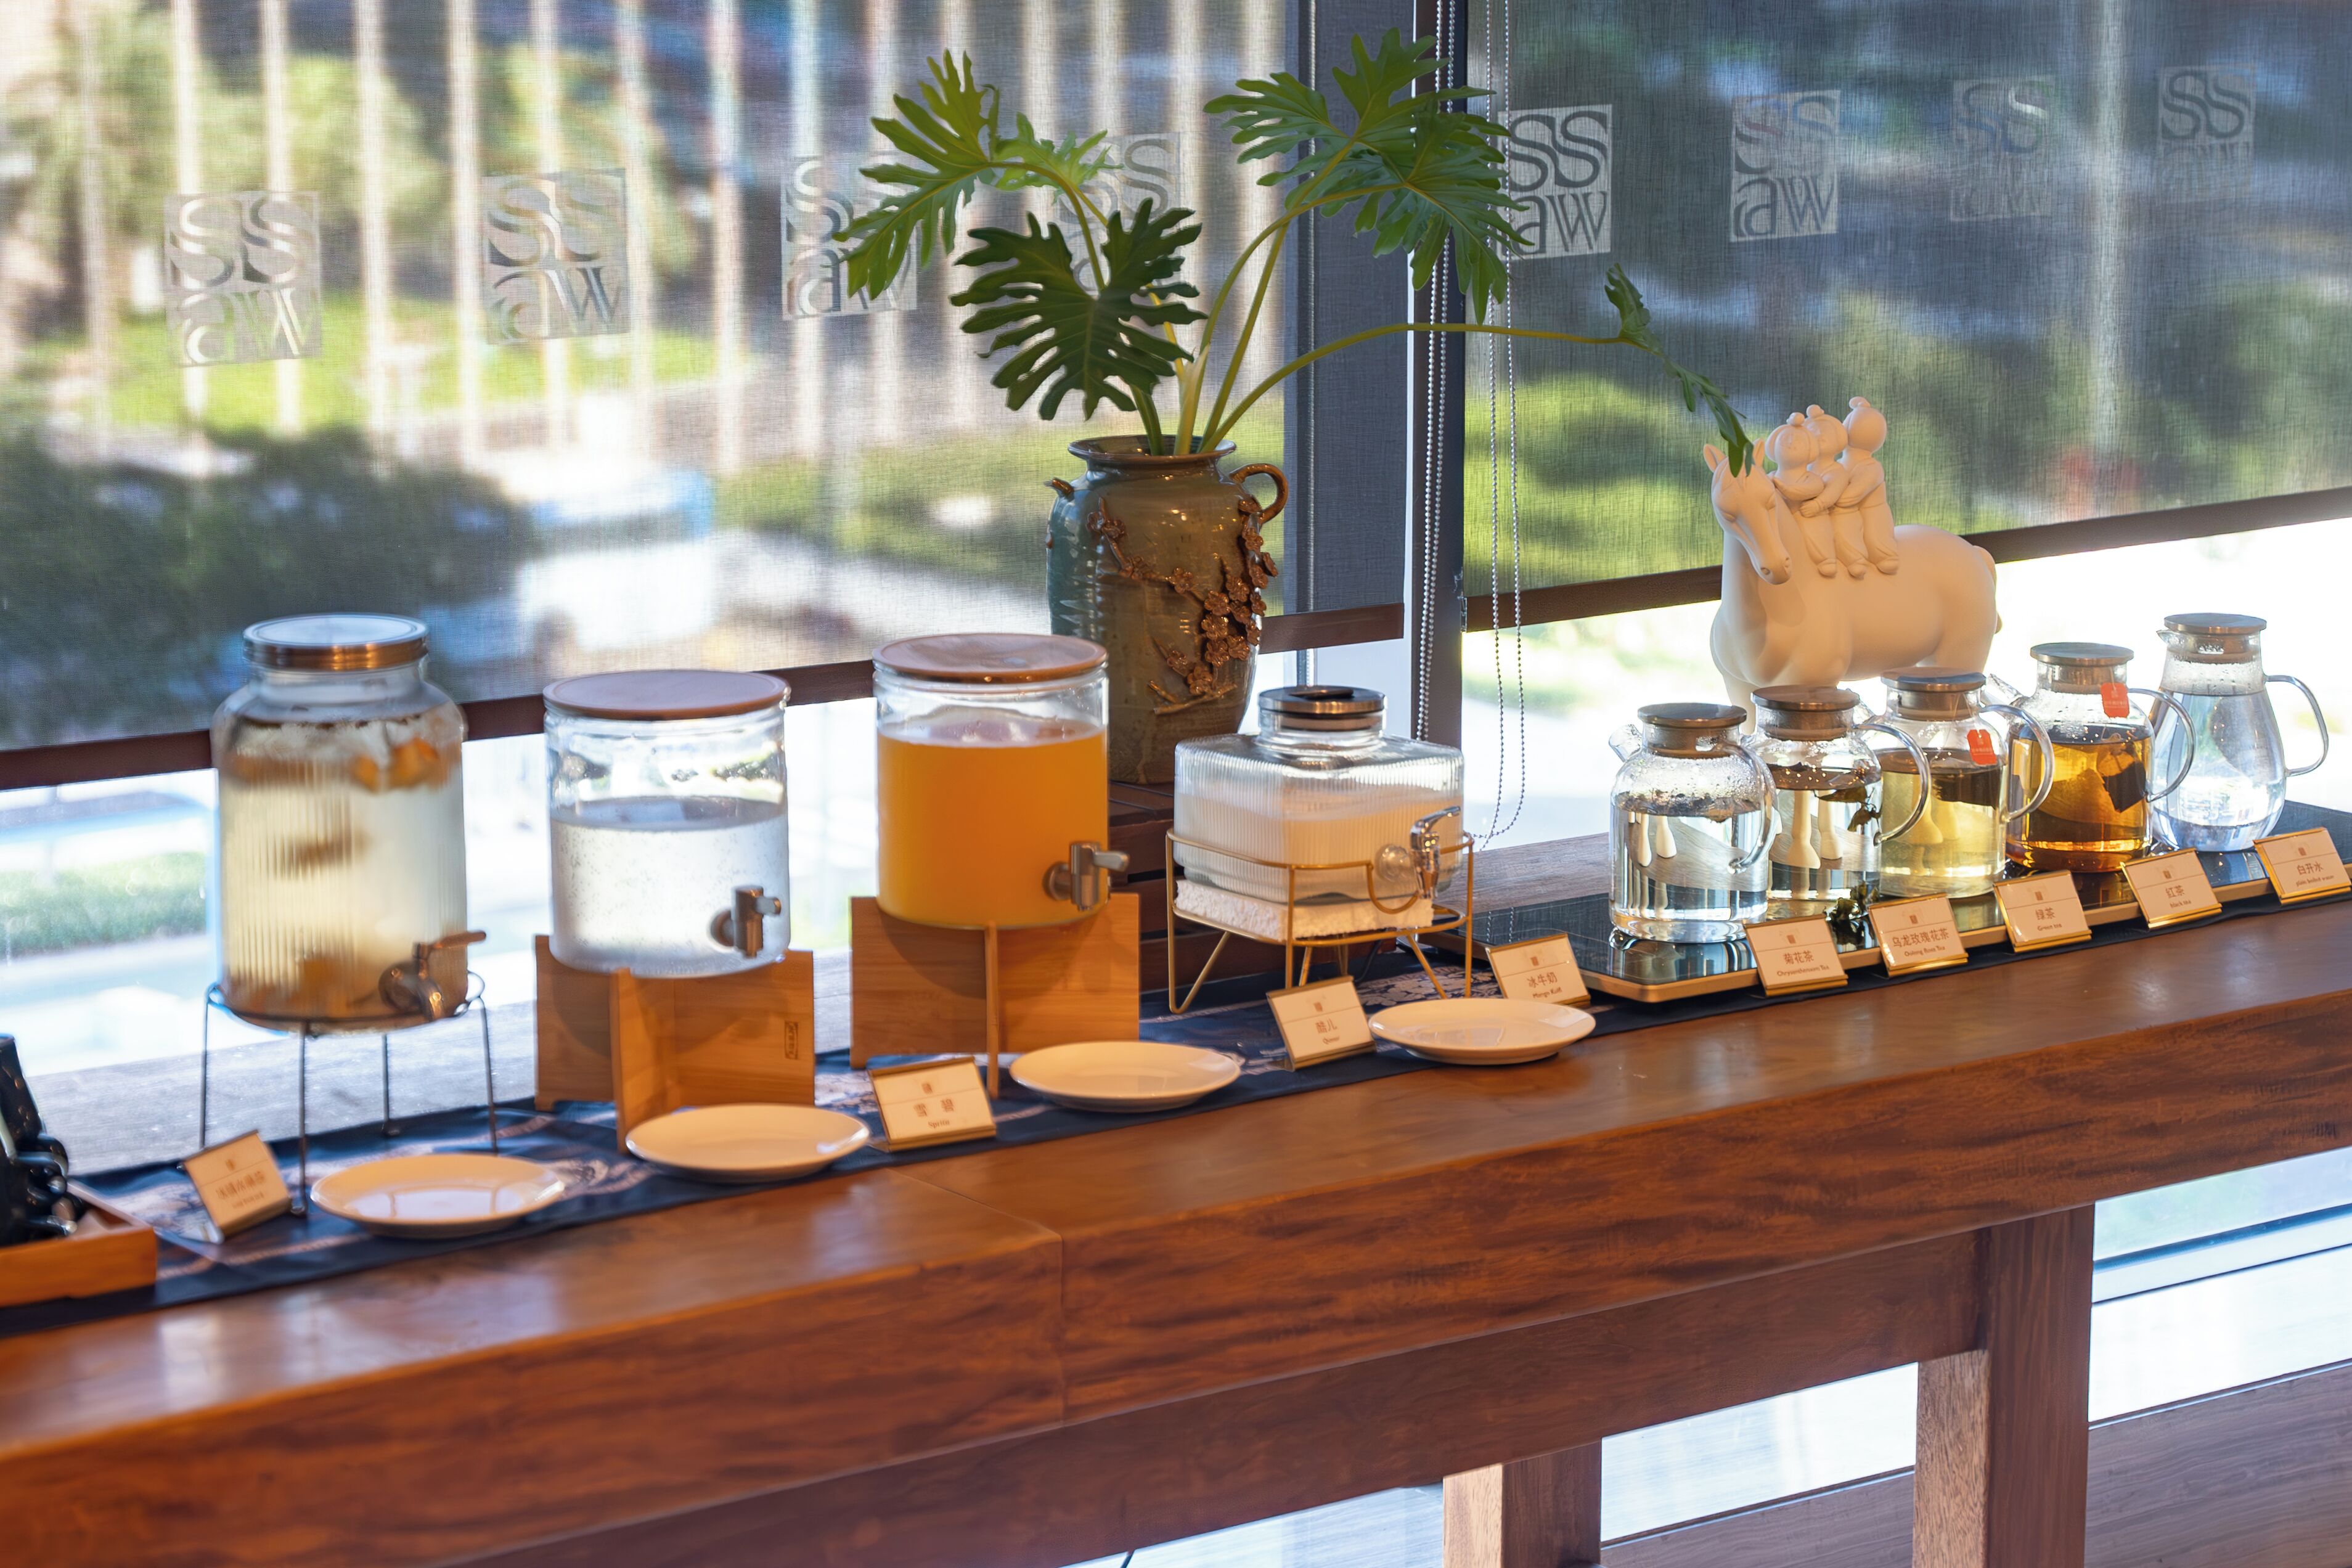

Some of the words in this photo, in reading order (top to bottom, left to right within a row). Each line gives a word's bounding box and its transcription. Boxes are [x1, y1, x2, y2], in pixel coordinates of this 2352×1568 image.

[2297, 860, 2323, 875] 白开水
[2165, 885, 2184, 898] 红茶
[2035, 907, 2055, 920] 绿茶
[1892, 928, 1950, 947] 乌龙玫瑰花茶
[1783, 950, 1814, 964] 菊花茶
[1527, 972, 1558, 988] 冰牛奶
